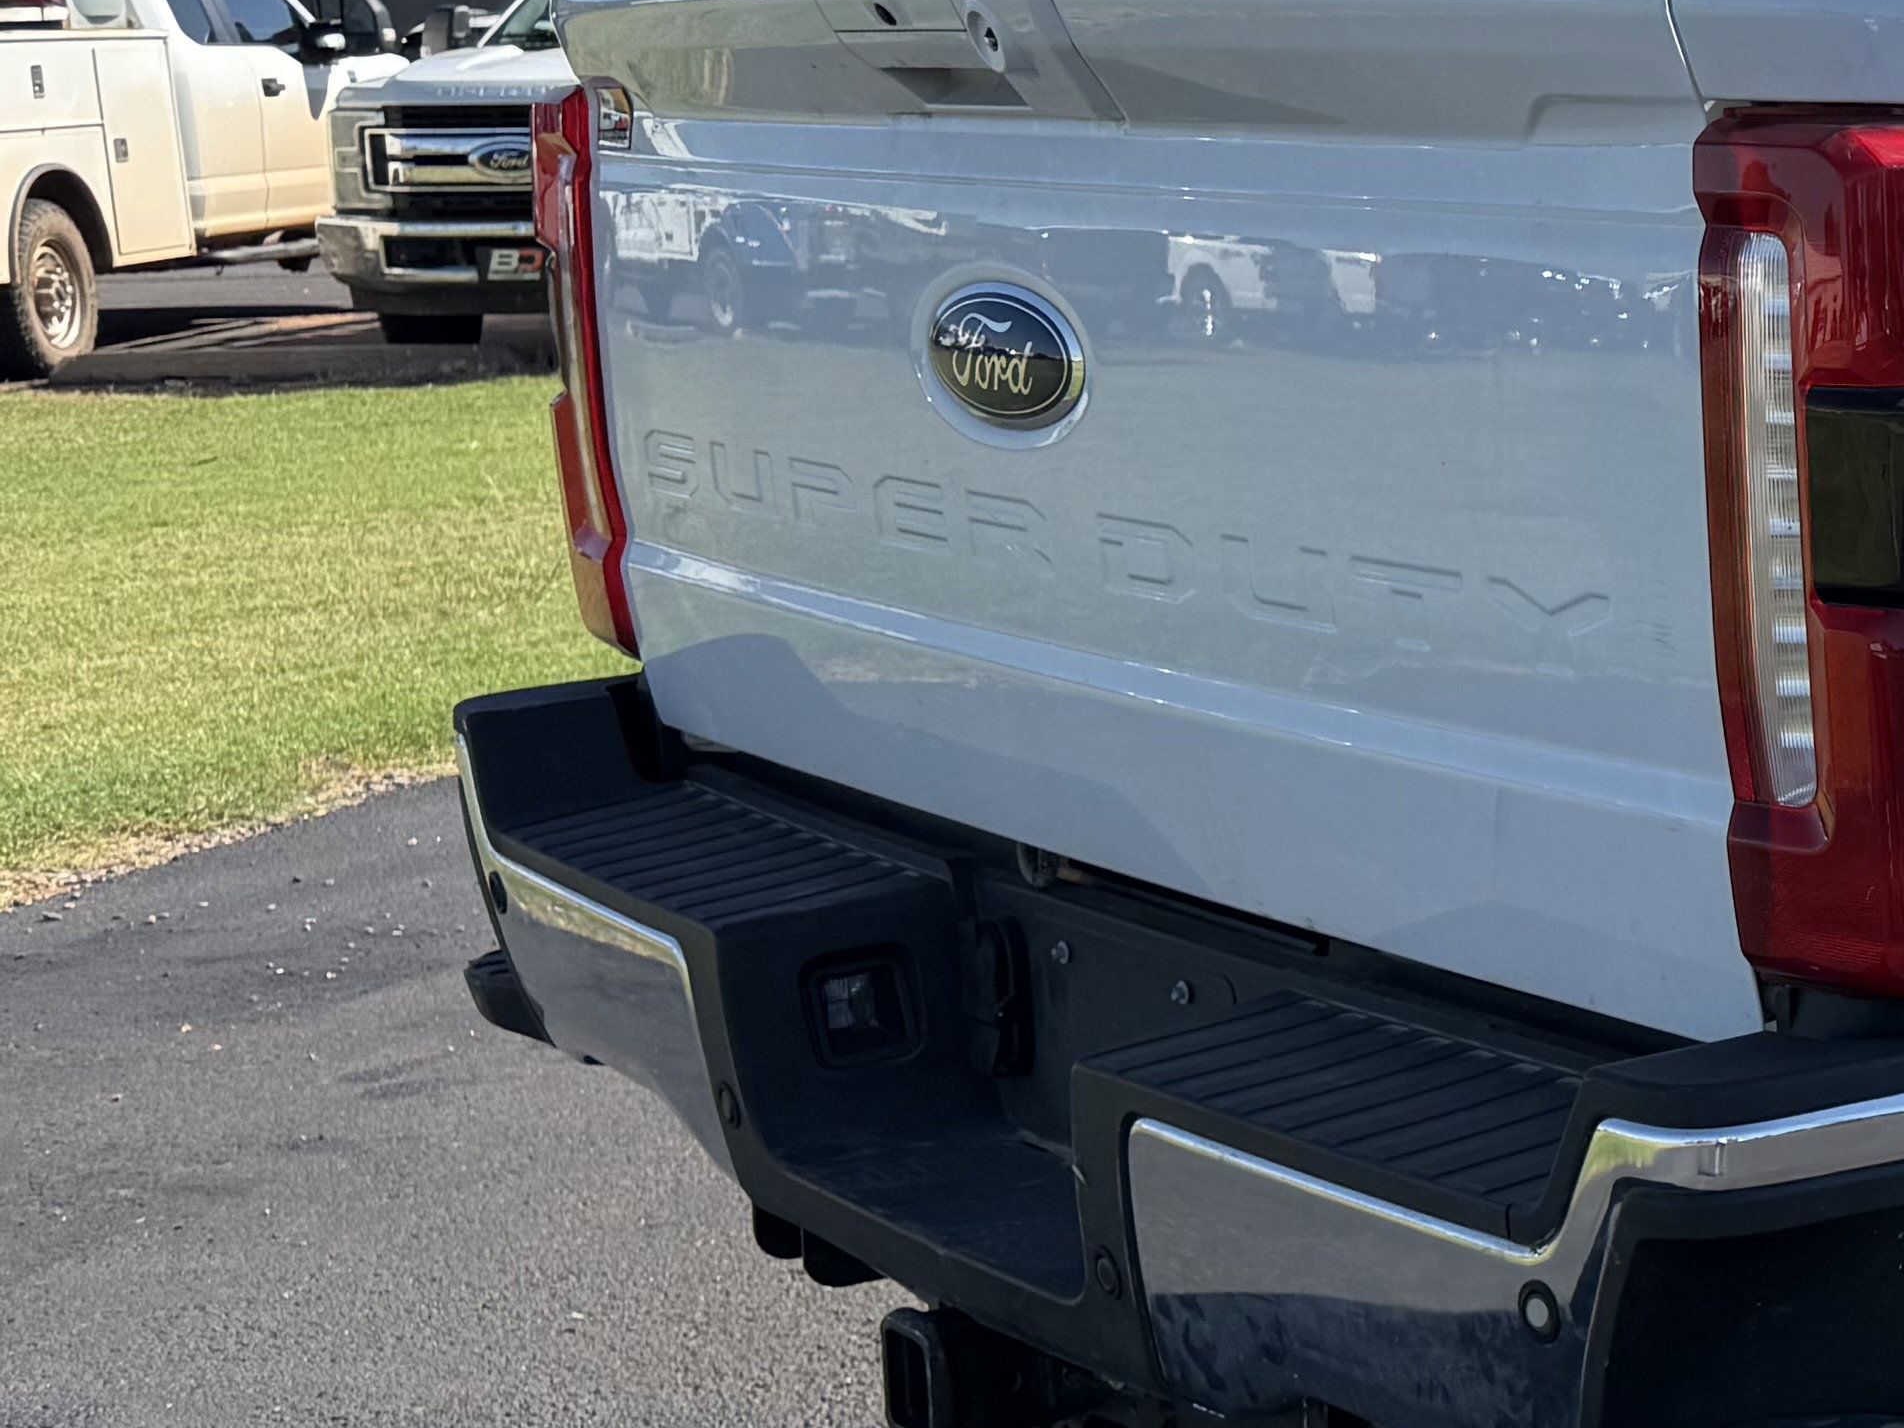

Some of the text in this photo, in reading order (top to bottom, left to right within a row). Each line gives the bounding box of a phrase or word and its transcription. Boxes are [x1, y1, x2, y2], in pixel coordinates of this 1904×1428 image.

[490, 149, 530, 170] Ford
[953, 312, 1034, 395] Ford
[643, 428, 1611, 676] SUPER DUTY
